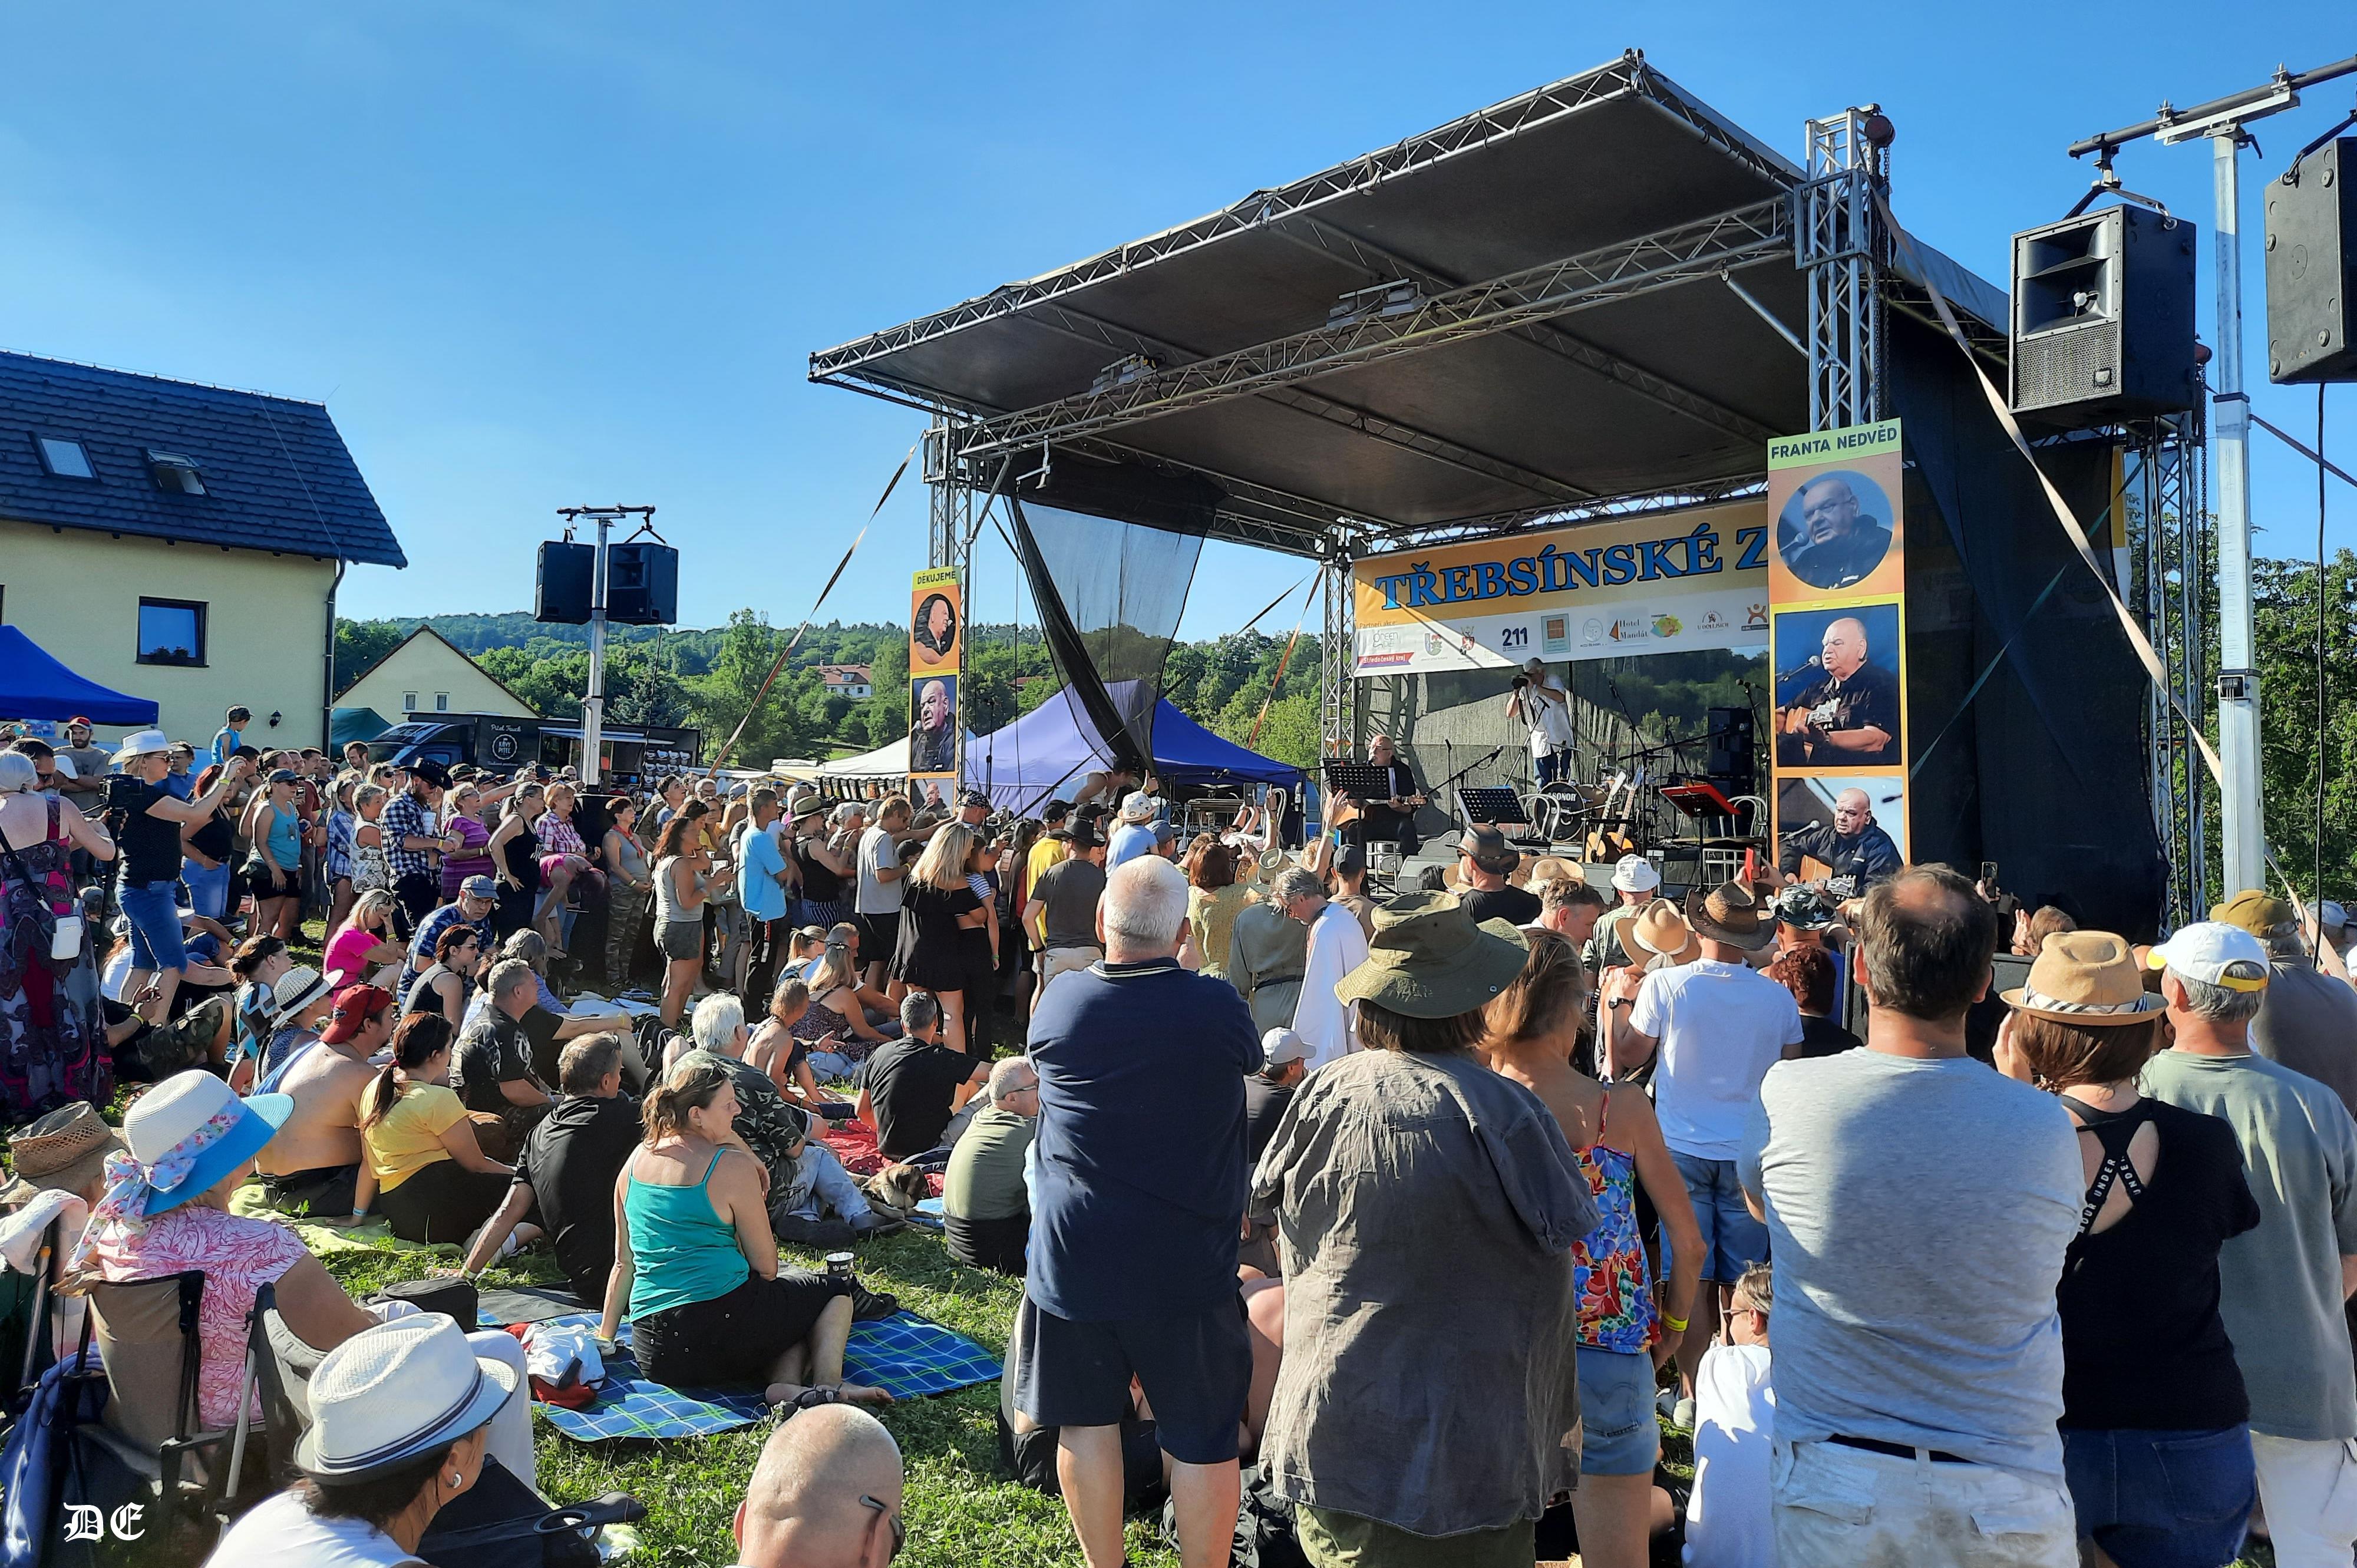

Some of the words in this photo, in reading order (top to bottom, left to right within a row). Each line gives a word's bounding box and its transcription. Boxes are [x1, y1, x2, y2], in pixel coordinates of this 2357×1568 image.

[1771, 439, 1831, 459] FRANTA
[1837, 424, 1897, 449] NEDVĚD
[1374, 523, 1723, 610] TŘEBSÍNSKÉ
[1502, 627, 1528, 646] 211
[1620, 619, 1639, 627] Hotel
[1620, 630, 1648, 639] Mandát
[1553, 792, 1577, 801] SONOR
[2094, 1158, 2116, 1197] UNDER
[2120, 1156, 2141, 1196] UNDE
